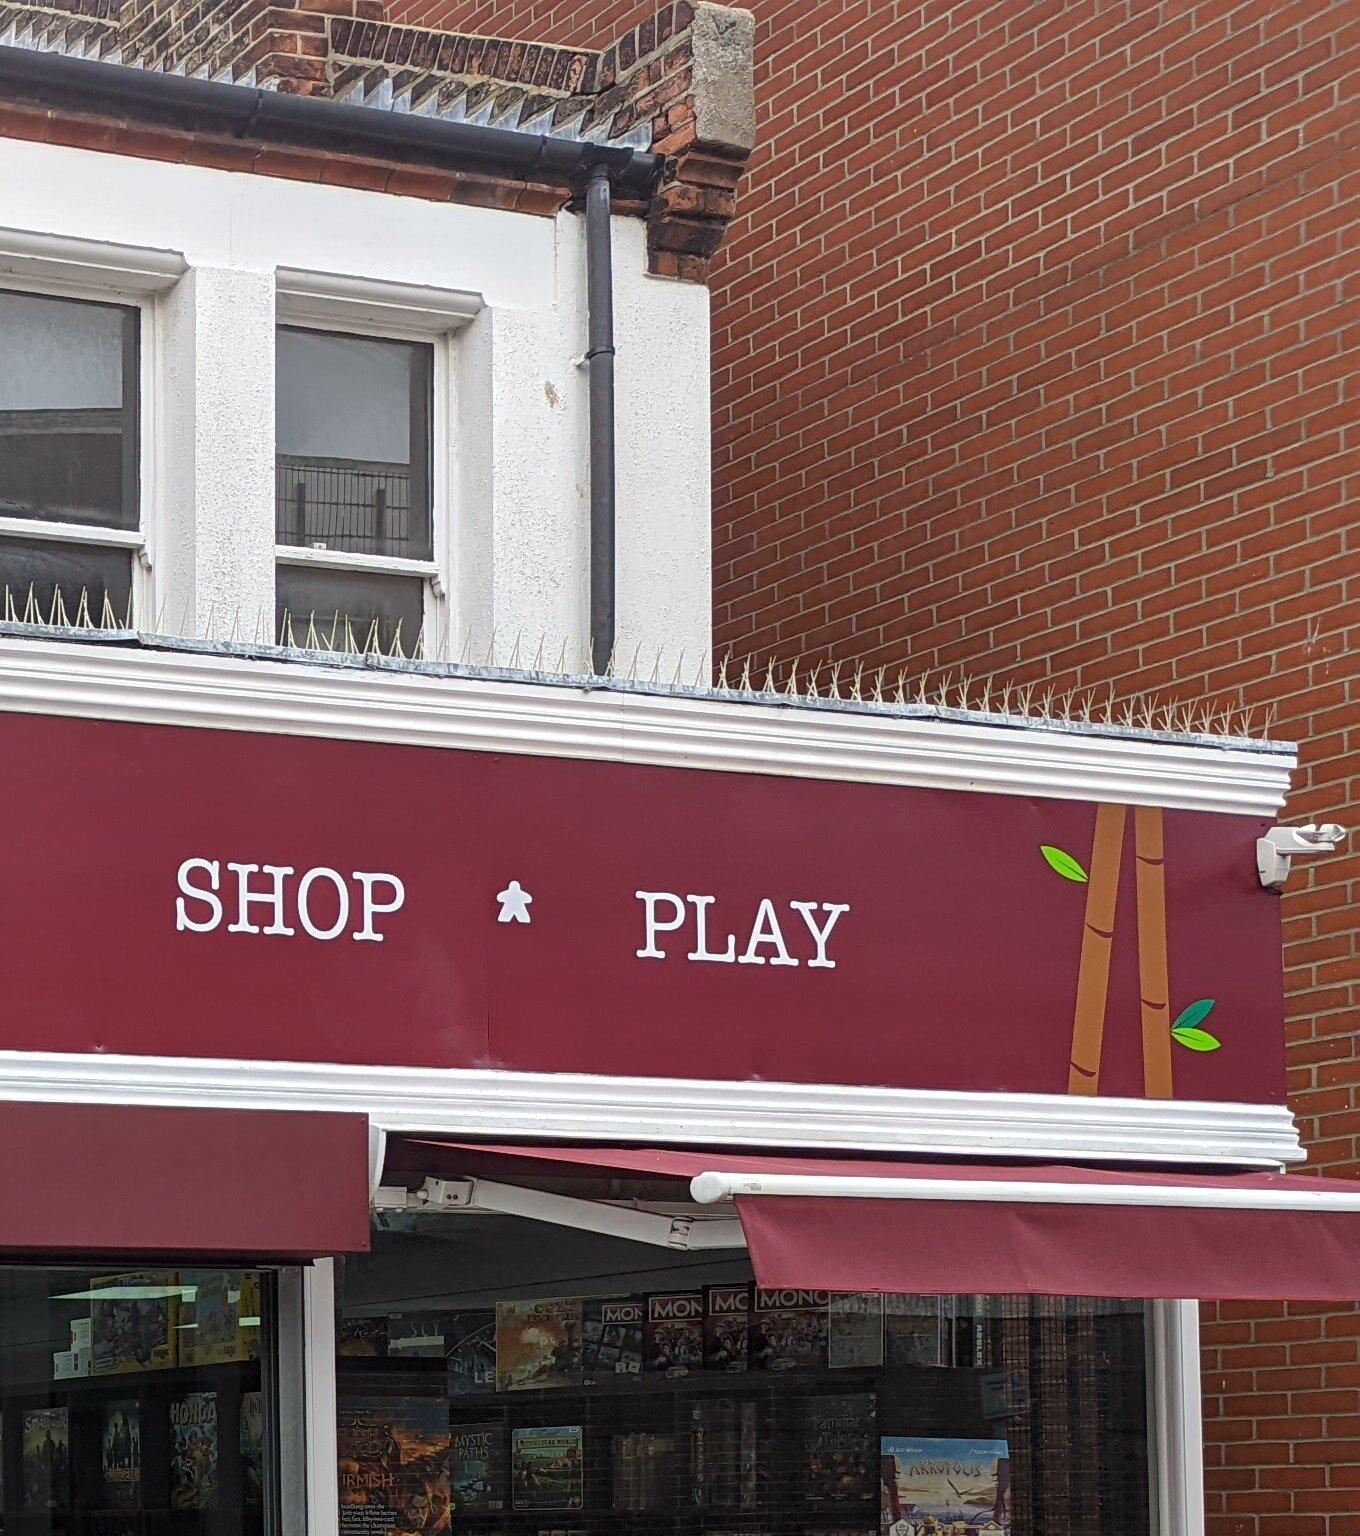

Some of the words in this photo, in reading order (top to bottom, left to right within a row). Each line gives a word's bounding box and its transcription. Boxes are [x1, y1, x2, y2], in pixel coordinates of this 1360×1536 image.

[176, 858, 404, 941] SHOP
[636, 891, 849, 968] PLAY
[454, 1432, 493, 1446] MYSTIC
[457, 1447, 489, 1459] PATHS
